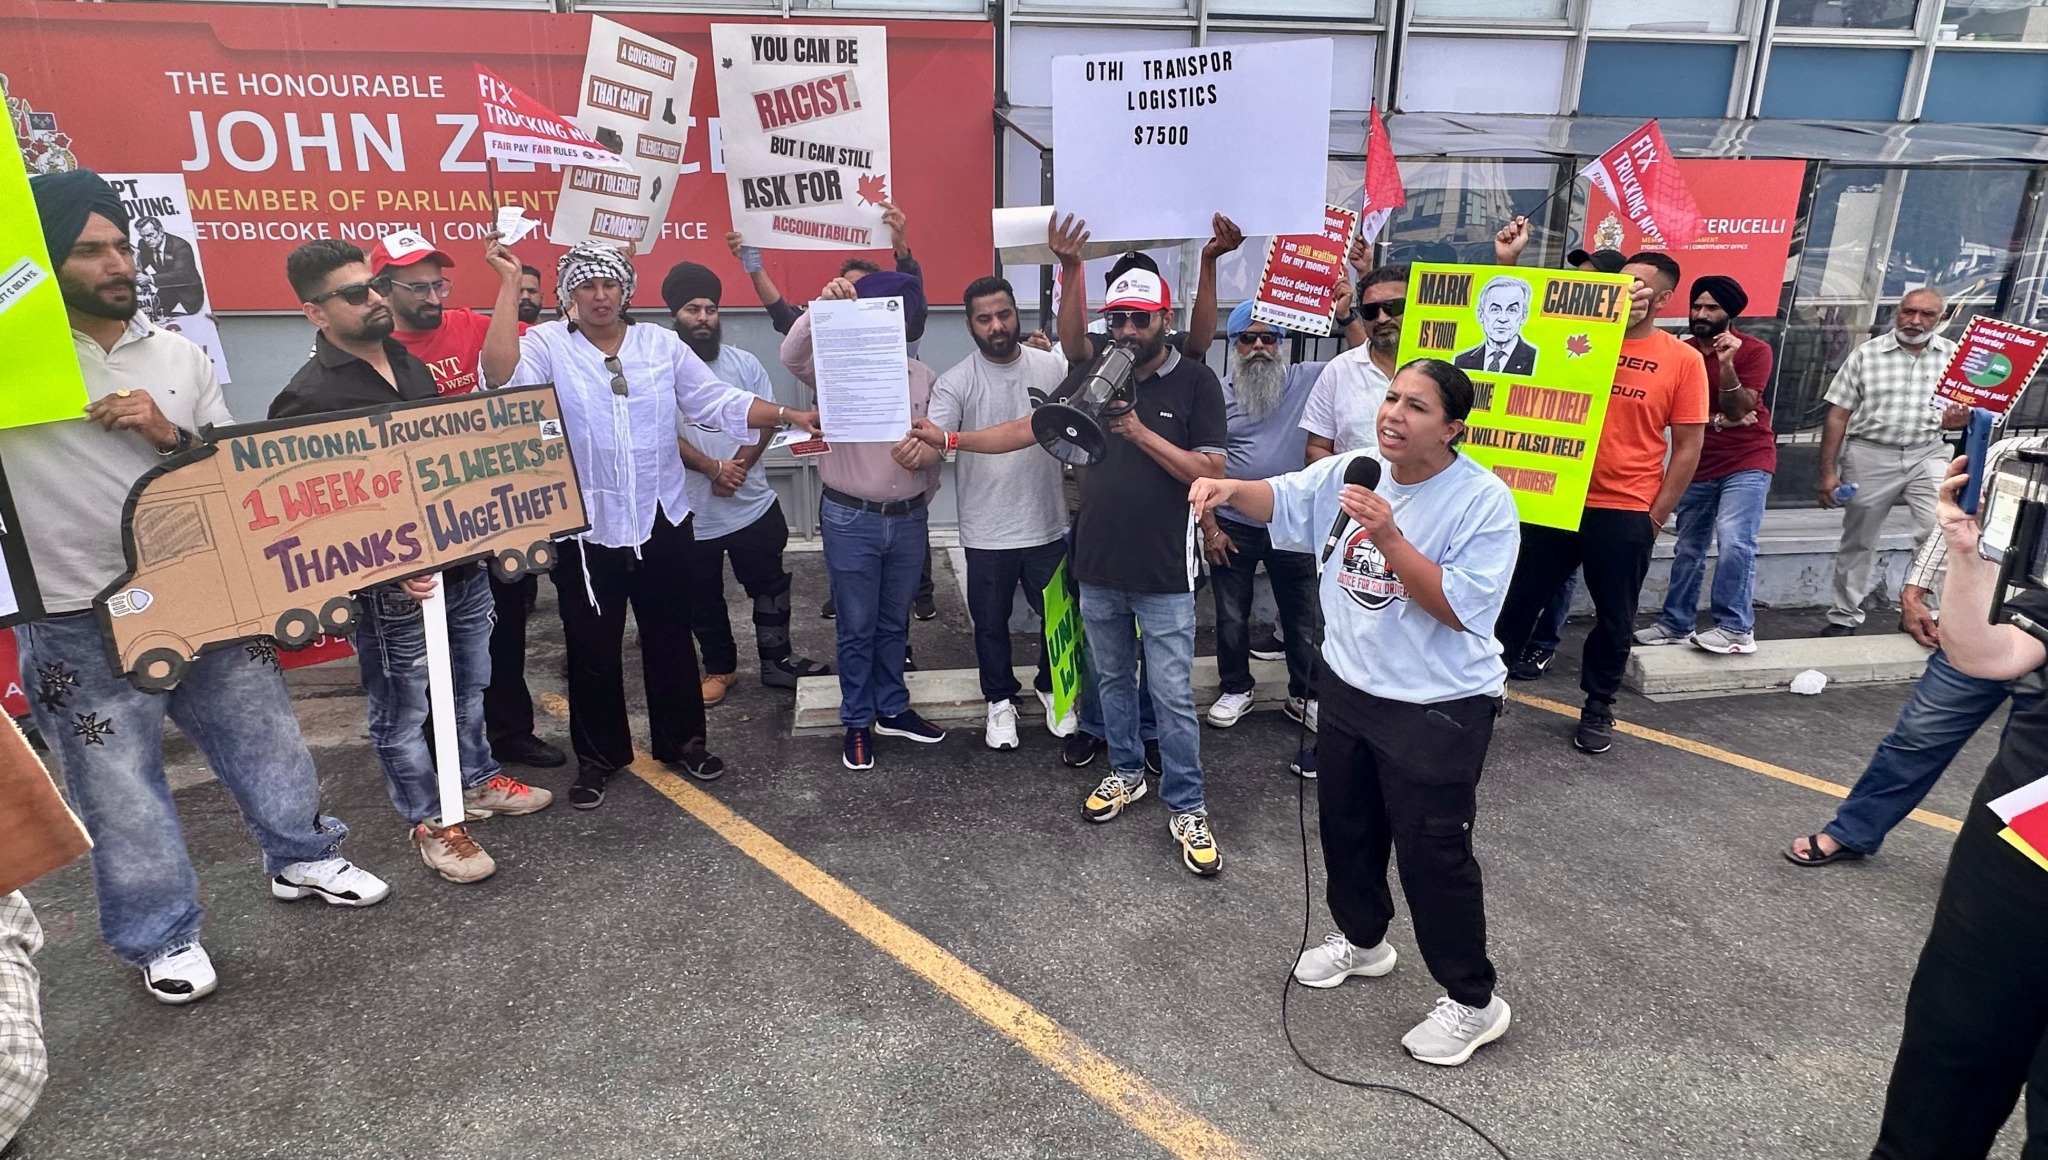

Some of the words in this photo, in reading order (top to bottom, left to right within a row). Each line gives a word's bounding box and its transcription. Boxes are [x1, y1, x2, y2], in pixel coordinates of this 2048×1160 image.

[621, 44, 627, 60] A
[628, 46, 674, 75] GOVERNMENT
[751, 36, 787, 62] YOU
[794, 37, 830, 63] CAN
[836, 39, 858, 64] BE
[1086, 61, 1123, 81] OTHI
[1143, 51, 1232, 81] TRANSPOR
[165, 71, 228, 95] THE
[238, 73, 445, 98] HONOURABLE
[593, 81, 620, 107] THAT
[620, 88, 650, 115] CAN'T
[1128, 84, 1217, 111] LOGISTICS
[754, 74, 861, 130] RACIST.
[483, 102, 567, 140] TRUCKING
[570, 126, 598, 144] NO
[1134, 125, 1188, 146] $7500
[181, 110, 406, 172] JOHN
[492, 140, 511, 151] FAIR
[513, 143, 528, 153] PAY
[532, 144, 552, 155] FAIR
[553, 145, 578, 157] RULES
[770, 136, 796, 157] BUT
[799, 141, 804, 158] I
[808, 143, 835, 163] CAN
[839, 147, 872, 168] STILL
[111, 179, 138, 199] PT
[573, 169, 602, 190] CAN'T
[602, 173, 639, 197] TOLERATE
[742, 175, 791, 209] ASK
[795, 169, 843, 204] FOR
[1612, 151, 1648, 220] TRUCKING
[127, 196, 181, 219] OVING.
[187, 189, 319, 212] MEMBER
[329, 190, 366, 211] OF
[377, 190, 558, 213] PARLIAMENT
[196, 221, 331, 241] ETOBICOKE
[661, 222, 709, 240] FICE
[594, 212, 648, 239] DEMOCRACY
[772, 215, 870, 245] ACCOUNTABILITY.
[1325, 217, 1344, 229] ment
[1703, 218, 1786, 234] ERUCELLI
[1329, 231, 1344, 243] ago.
[1281, 240, 1285, 249] I
[1285, 241, 1297, 253] am
[1297, 244, 1312, 256] still
[1312, 249, 1338, 265] waiting
[1281, 253, 1292, 264] for
[1293, 257, 1304, 269] my
[1305, 261, 1331, 275] money.
[1269, 273, 1294, 288] Justice
[1294, 279, 1323, 296] delayed
[1323, 287, 1330, 297] is
[1271, 288, 1293, 301] wages
[1294, 293, 1321, 307] denied.
[1418, 273, 1472, 306] MARK
[1543, 281, 1622, 323] CARNEY,
[1419, 321, 1432, 348] IS
[1433, 322, 1458, 350] YOUR
[1969, 335, 2006, 350] yesterday.
[1979, 326, 2007, 340] worked
[2006, 332, 2016, 342] 12
[2015, 336, 2037, 347] hours
[1617, 355, 1659, 374] DER
[446, 373, 476, 390] WEST
[1611, 385, 1647, 400] OUR
[1941, 386, 1951, 395] for
[1944, 378, 1957, 387] But
[1960, 383, 1975, 393] was
[1975, 387, 1992, 399] only
[1990, 391, 2009, 402] paid
[1507, 384, 1541, 418] ONLY
[1540, 389, 1558, 420] TO
[1556, 391, 1592, 425] HELP
[231, 427, 377, 473] NATIONAL
[370, 408, 487, 449] TRUCKING
[486, 397, 549, 429] WEEK
[1471, 427, 1500, 448] WILL
[1502, 431, 1516, 449] IT
[1517, 433, 1550, 453] ALSO
[1551, 437, 1586, 458] HELP
[416, 453, 460, 493] 51
[459, 437, 545, 483] WEEKS
[545, 441, 565, 462] OF
[1518, 469, 1555, 493] DRIVERS?
[243, 488, 280, 531] 1
[278, 468, 370, 522] WEEK
[373, 470, 403, 500] OF
[426, 498, 501, 552] WAGE
[491, 481, 568, 532] THEFT
[264, 521, 423, 593] THANKS
